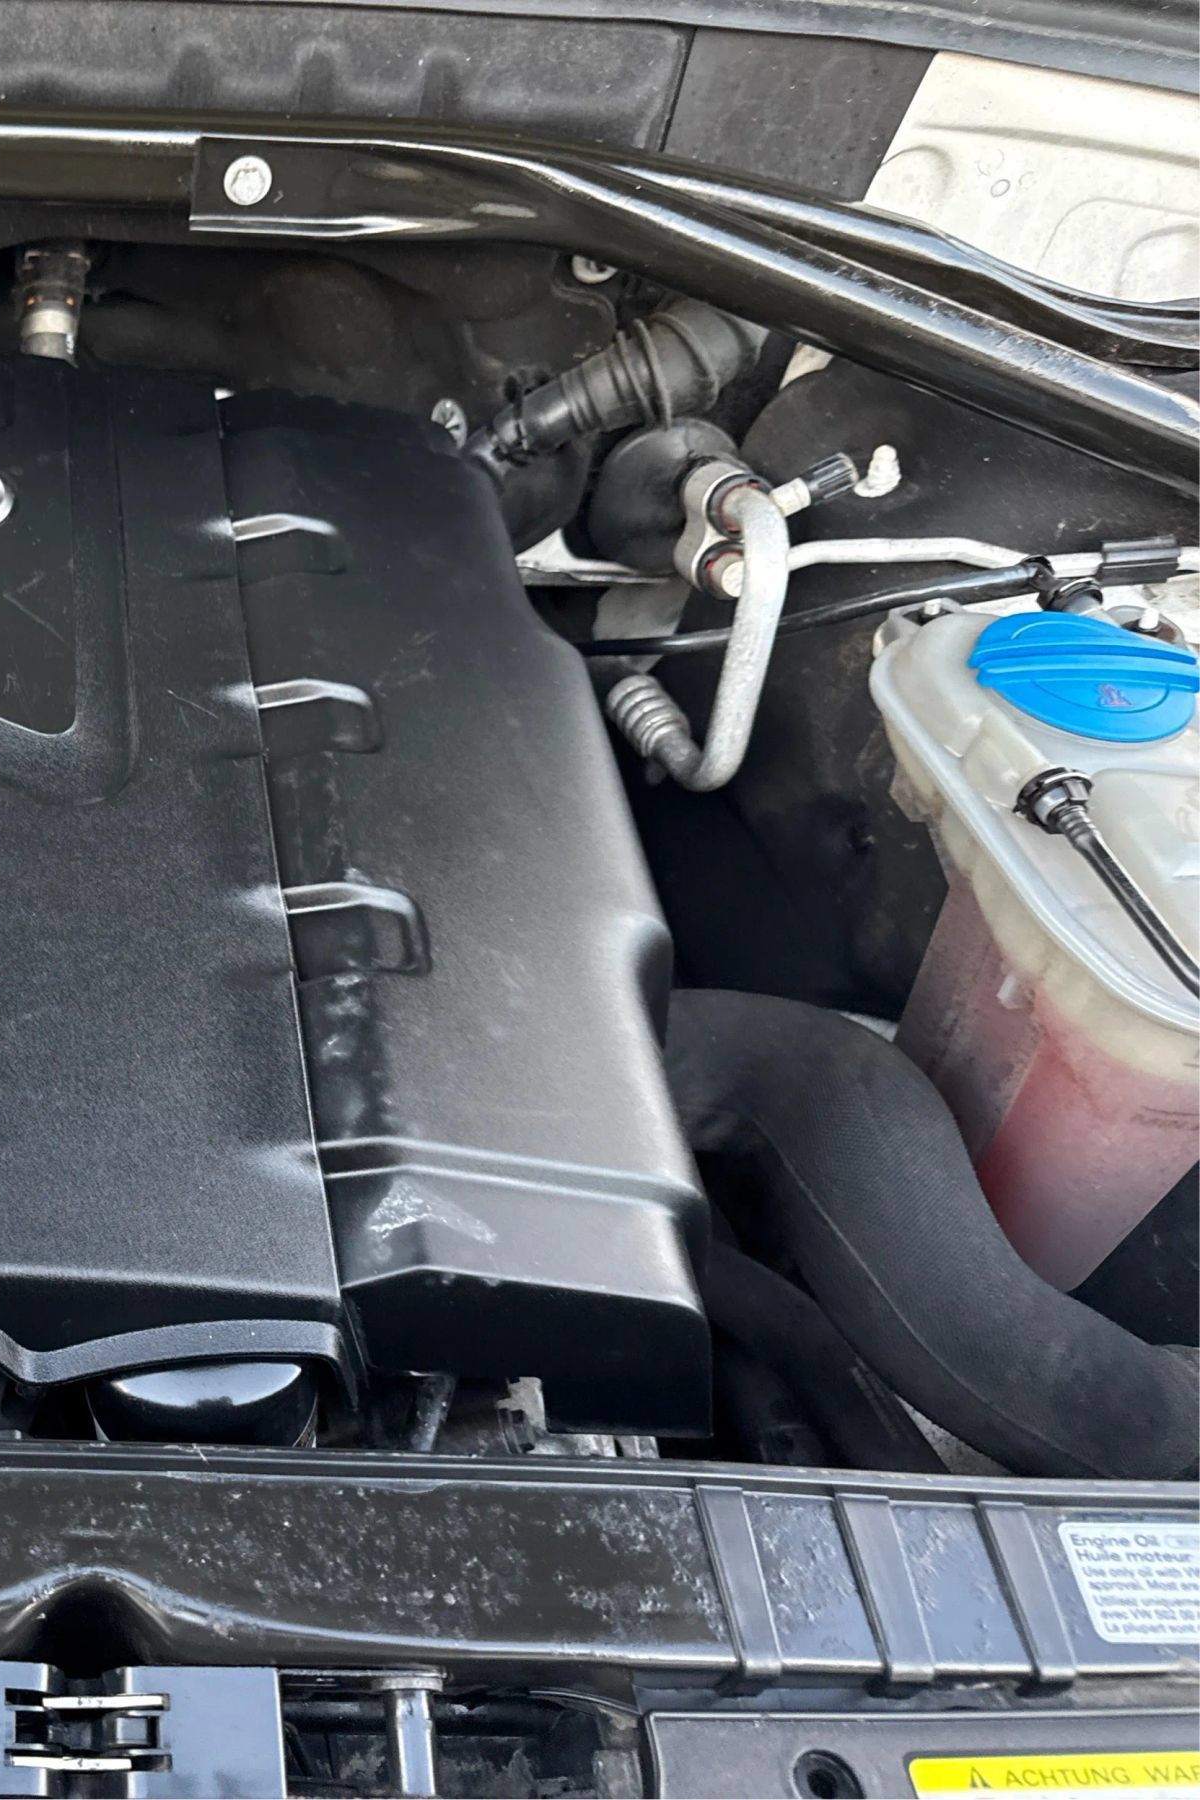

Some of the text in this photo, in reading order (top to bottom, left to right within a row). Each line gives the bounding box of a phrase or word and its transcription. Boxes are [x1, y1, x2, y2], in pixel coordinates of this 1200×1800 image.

[1070, 1533, 1130, 1549] Engine
[1133, 1533, 1160, 1548] Oil
[1075, 1547, 1192, 1562] Huile moteur
[1108, 1566, 1135, 1578] only
[1155, 1565, 1184, 1578] with
[1006, 1767, 1131, 1787] ACHTUNG
